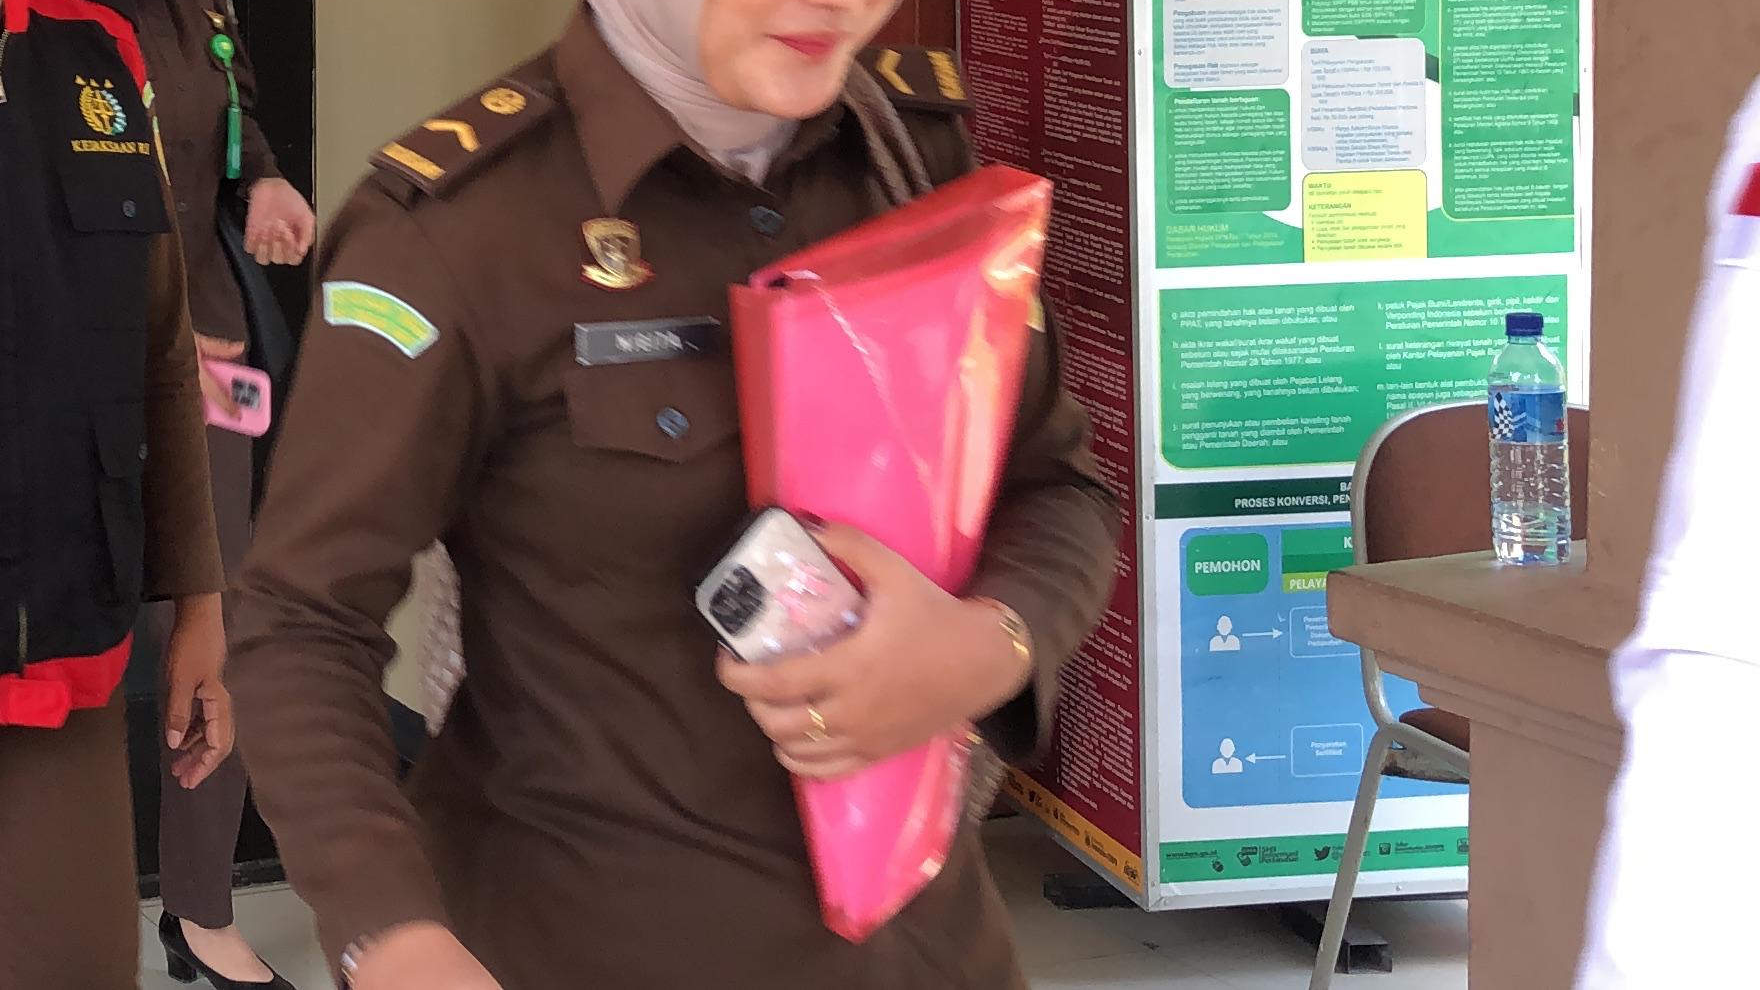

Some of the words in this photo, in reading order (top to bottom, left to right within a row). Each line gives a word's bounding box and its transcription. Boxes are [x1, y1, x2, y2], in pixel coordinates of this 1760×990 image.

[1235, 497, 1275, 508] PROSES
[1277, 495, 1330, 507] KONVERSI,
[1195, 560, 1260, 573] PEMOHON
